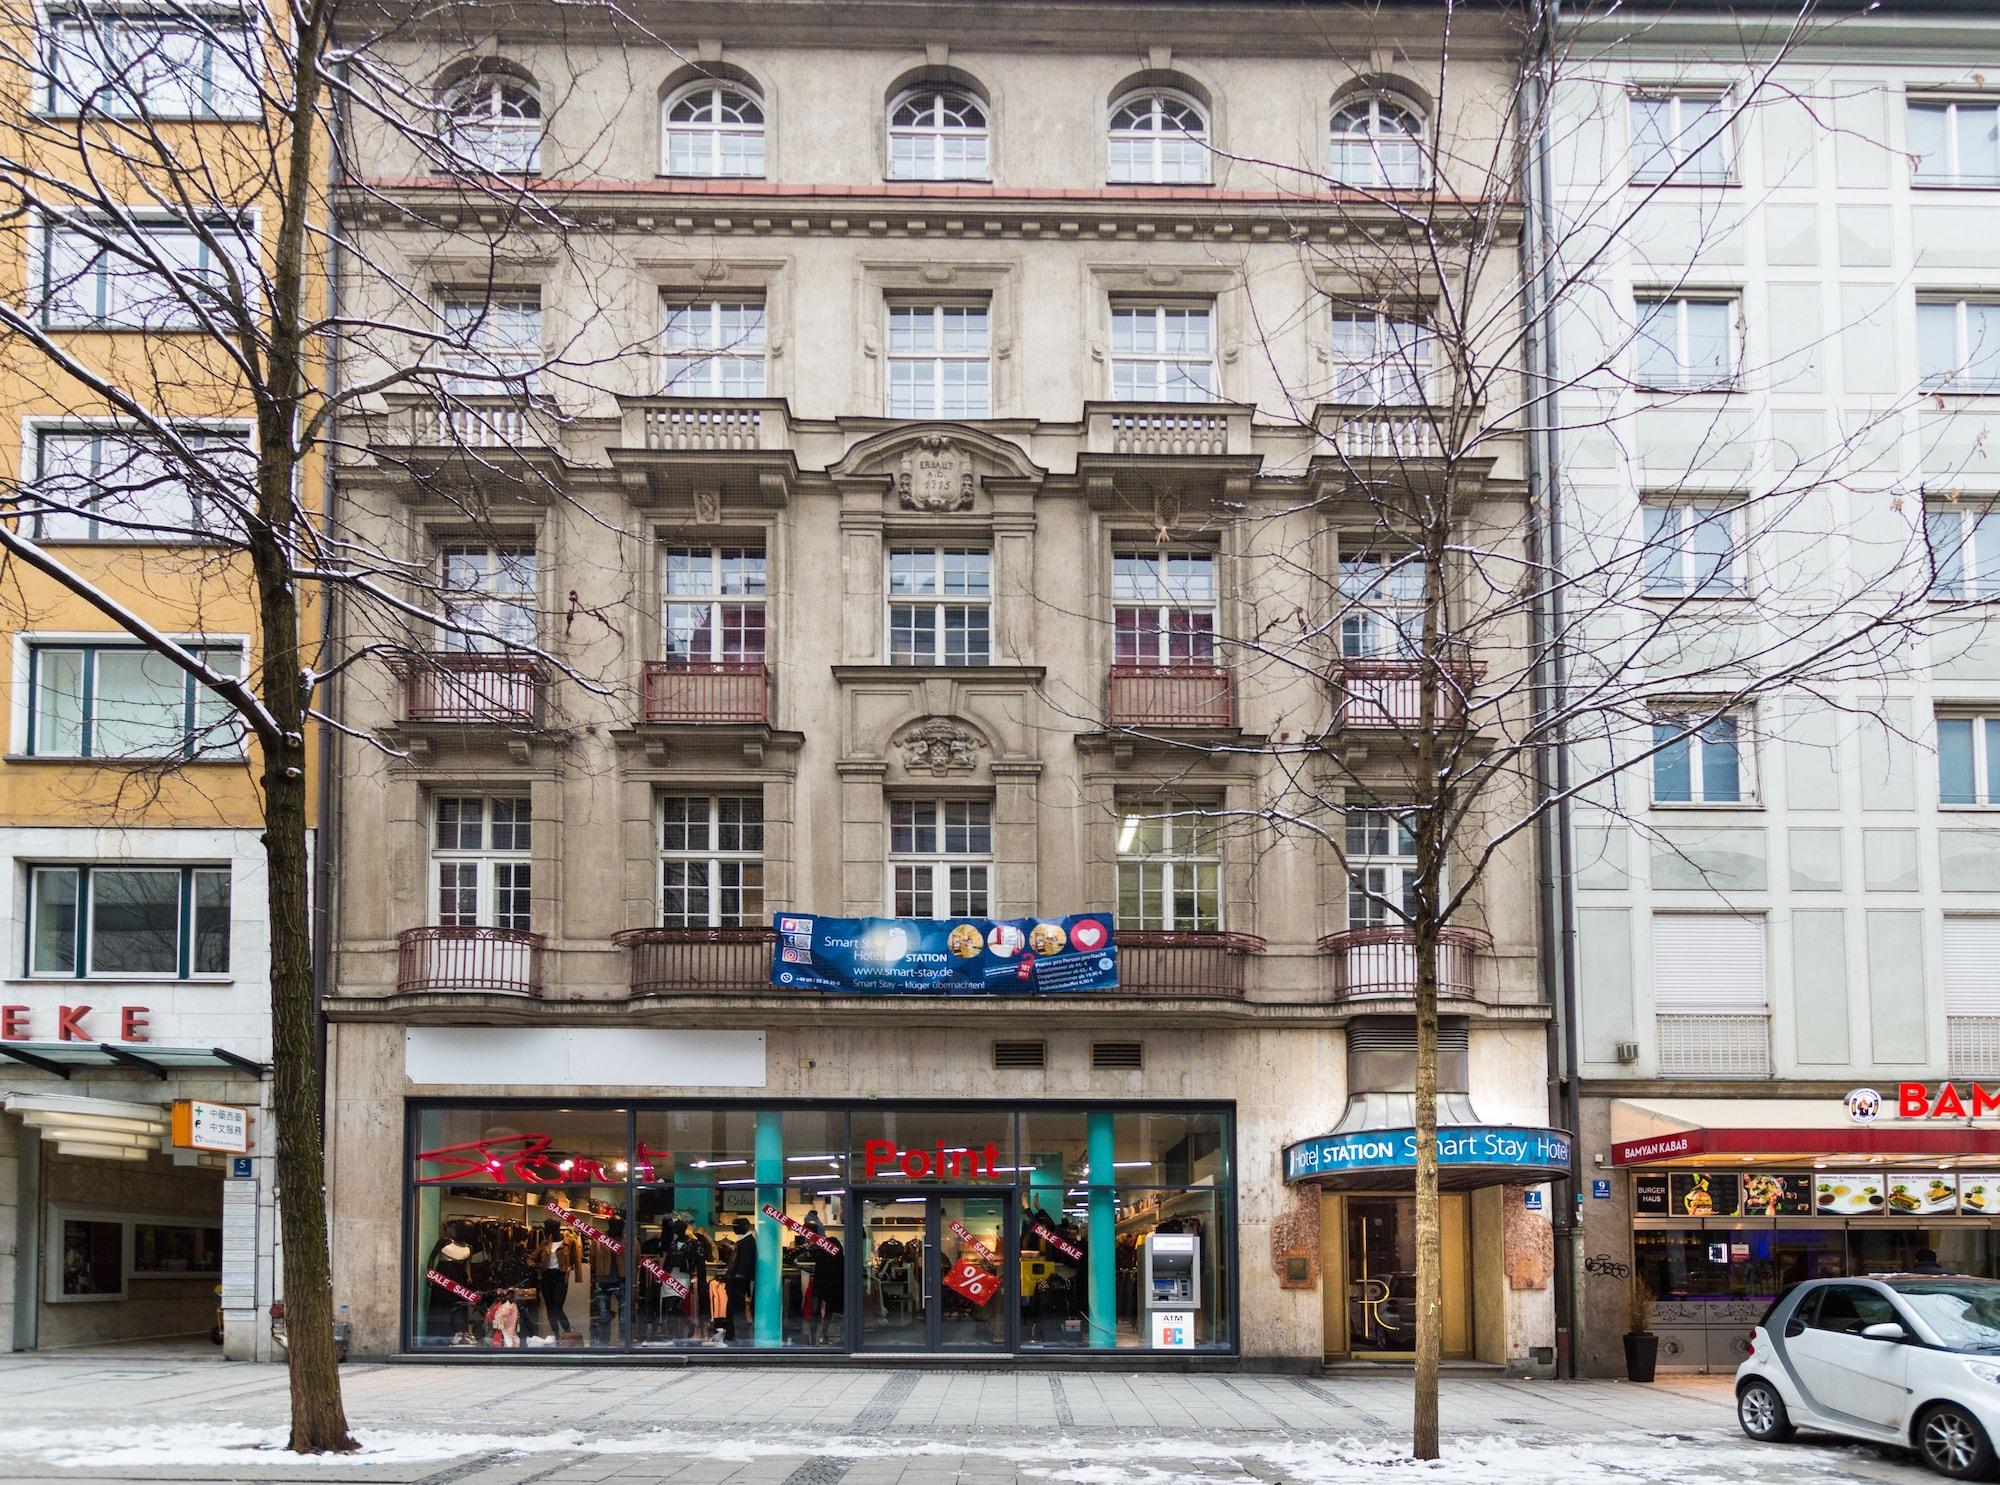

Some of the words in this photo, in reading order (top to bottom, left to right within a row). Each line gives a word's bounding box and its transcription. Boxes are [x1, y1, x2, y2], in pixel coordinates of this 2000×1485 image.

[824, 936, 858, 949] Smart
[854, 950, 884, 961] Hotel
[906, 953, 948, 962] STATION
[853, 967, 954, 979] www.smart-stay.de
[853, 979, 877, 988] Smart
[879, 980, 896, 990] Stay
[905, 981, 930, 991] klüger
[932, 981, 986, 990] übernachten!
[1898, 1082, 2000, 1118] BAM
[865, 1139, 999, 1179] Point
[1323, 1142, 1393, 1163] STATION
[1484, 1134, 1528, 1161] Stay
[1537, 1137, 1568, 1160] Hotel
[1624, 1144, 1658, 1158] BAMYAN
[1659, 1139, 1688, 1153] KABAB
[239, 1159, 246, 1168] 5
[1529, 1193, 1536, 1201] 7
[1598, 1181, 1606, 1190] 9
[1643, 1195, 1662, 1203] HAUS
[547, 1203, 570, 1220] SALE
[572, 1218, 595, 1236] SALE
[598, 1235, 620, 1253] SALE
[766, 1207, 788, 1224] SALE
[791, 1223, 814, 1240] SALE
[816, 1238, 840, 1256] SALE
[951, 1223, 973, 1242] SALE
[974, 1242, 995, 1261] SALE
[1035, 1226, 1058, 1244] SALE
[1060, 1242, 1083, 1260] SALE
[427, 1270, 450, 1287] SALE
[453, 1285, 477, 1302] SALE
[642, 1259, 665, 1278] SALE
[666, 1277, 688, 1296] SALE
[960, 1265, 986, 1295] %
